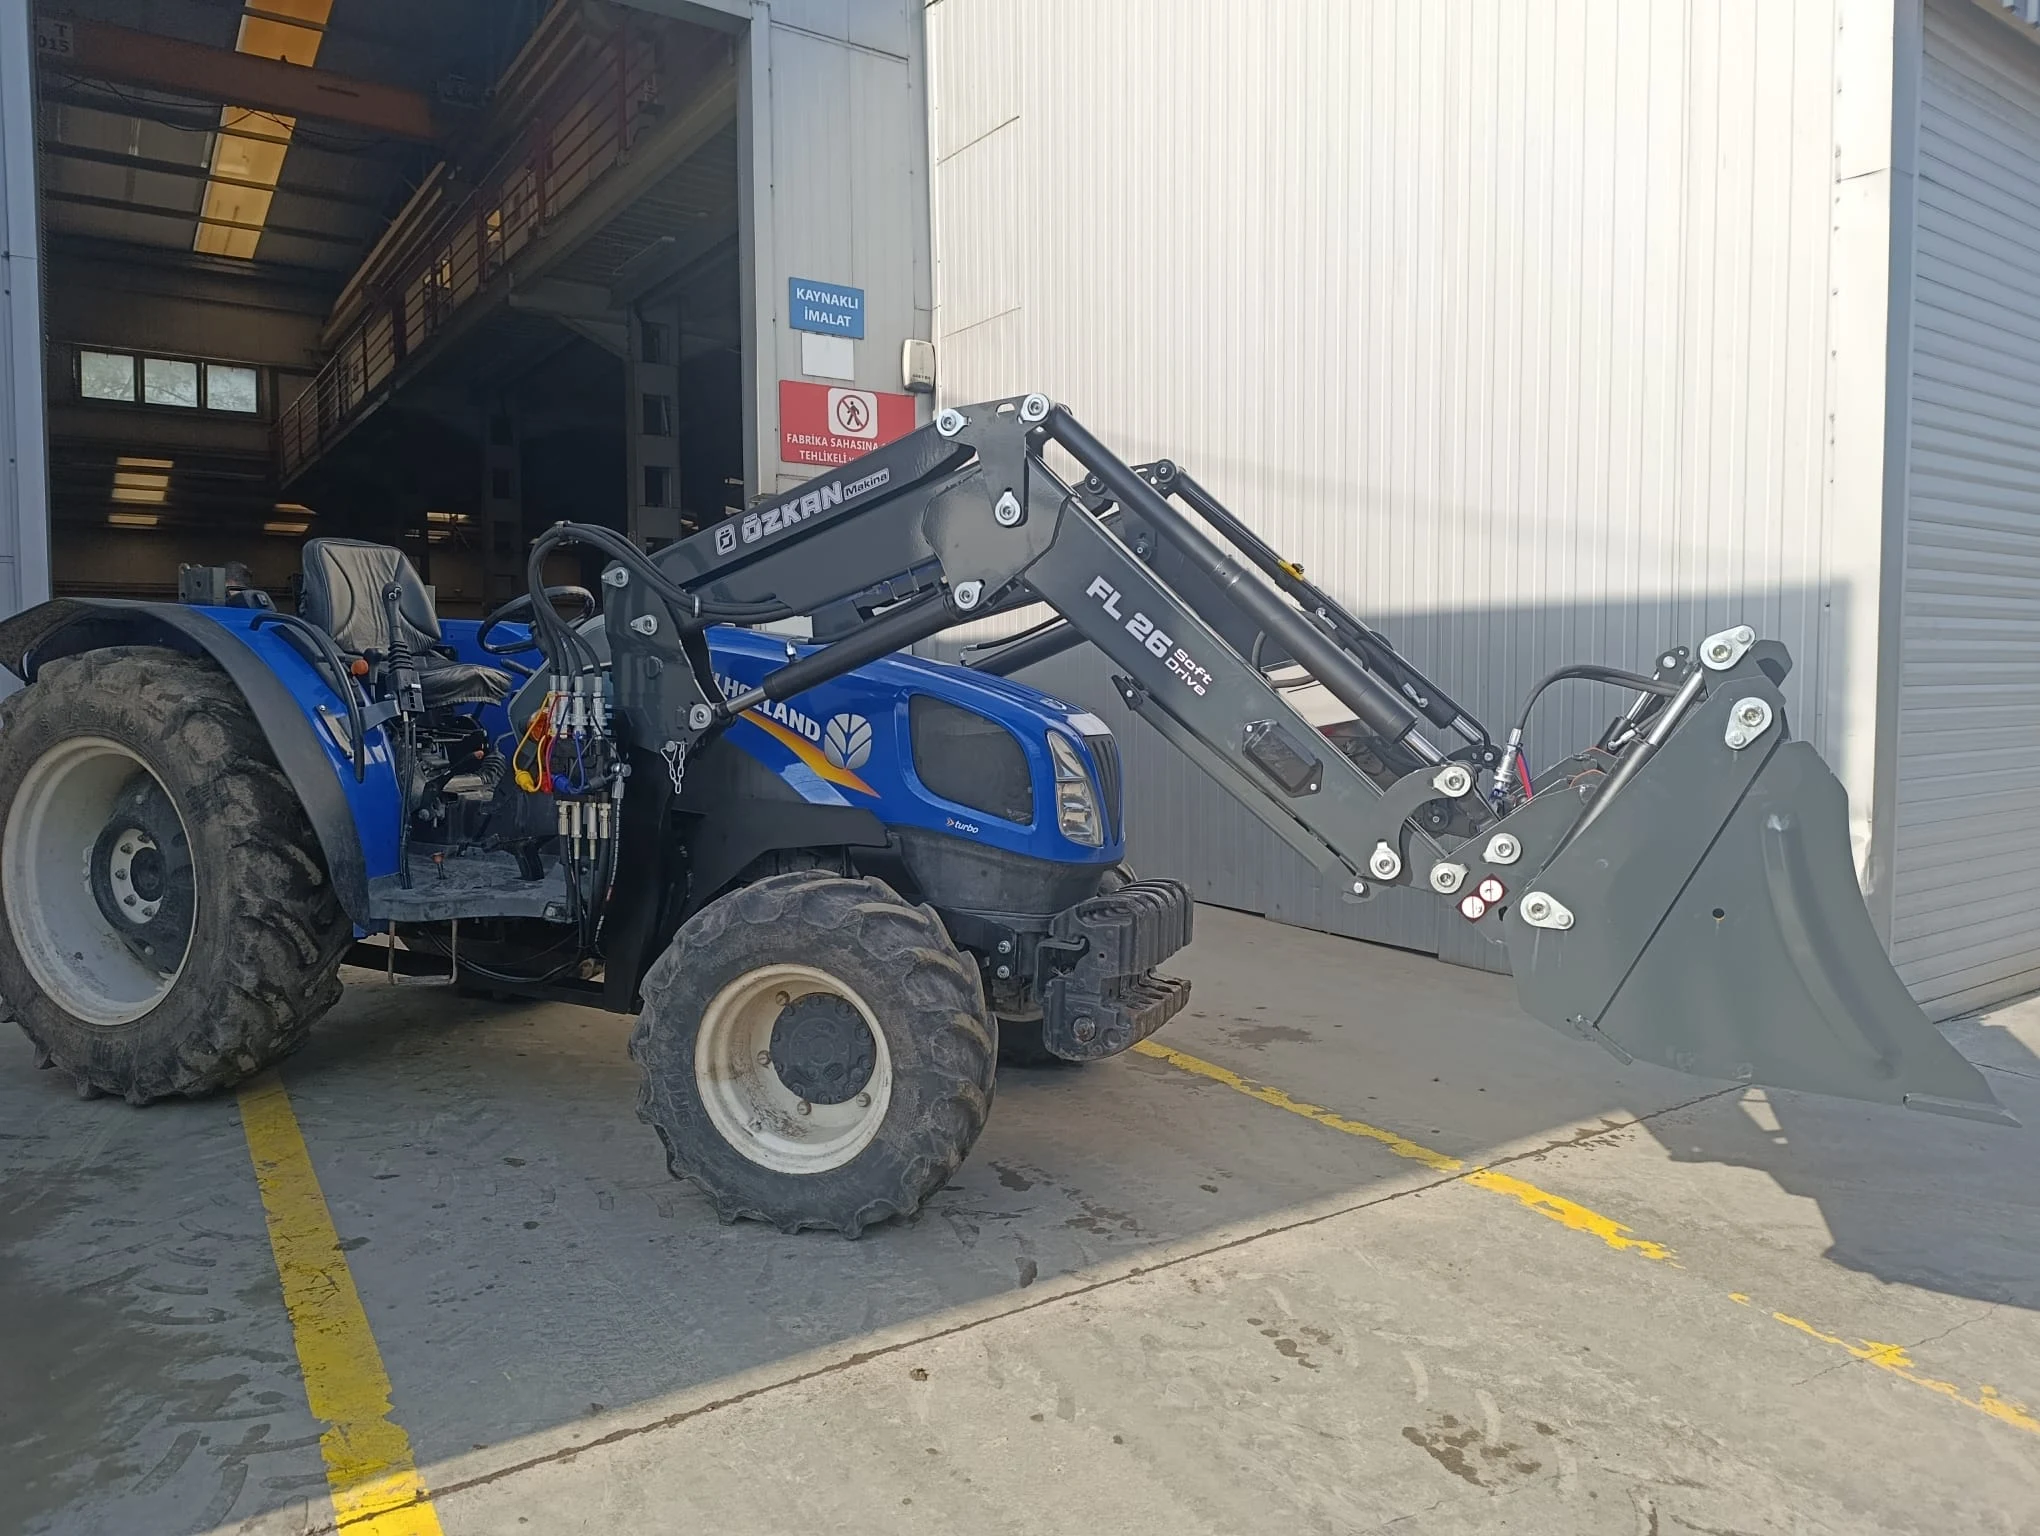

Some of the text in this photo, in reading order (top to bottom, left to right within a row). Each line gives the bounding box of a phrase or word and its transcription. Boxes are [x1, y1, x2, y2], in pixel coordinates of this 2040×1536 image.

[796, 287, 858, 309] KAYNAKLI
[804, 306, 851, 327] İMALAT
[786, 433, 828, 447] FABRİKA
[799, 450, 847, 464] TEHLİKELİ
[742, 481, 844, 544] ÖZKAN
[845, 472, 888, 497] Makina
[1086, 575, 1174, 658] FL 26
[1164, 657, 1206, 696] Drive
[1173, 648, 1213, 685] Soft
[723, 676, 821, 742] HLAND
[954, 820, 979, 834] turbo
